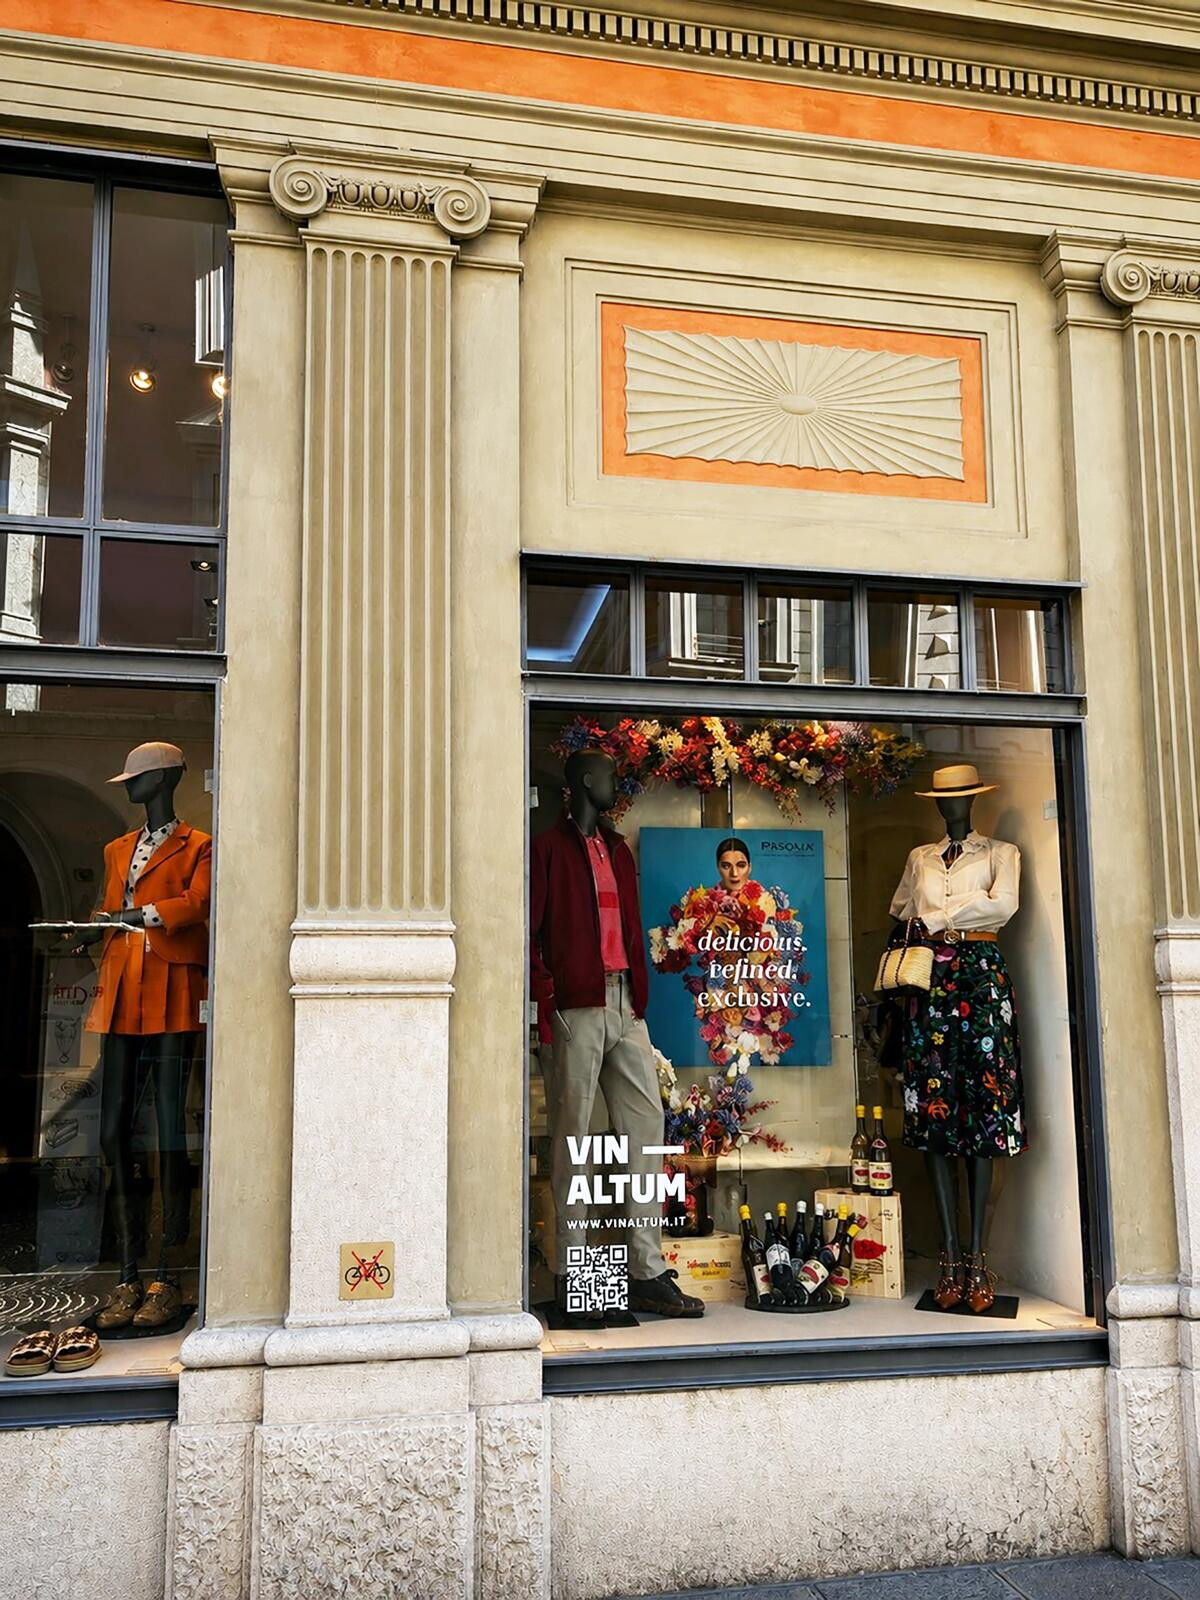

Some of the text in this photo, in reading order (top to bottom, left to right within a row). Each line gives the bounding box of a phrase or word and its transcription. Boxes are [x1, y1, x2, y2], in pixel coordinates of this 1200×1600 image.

[697, 930, 808, 952] delicious.
[709, 958, 797, 984] refined.
[697, 986, 811, 1008] exclusive.
[566, 1135, 628, 1165] VIN
[566, 1173, 686, 1205] ALTUM
[566, 1216, 687, 1230] WWW.VINALTUM.IT
